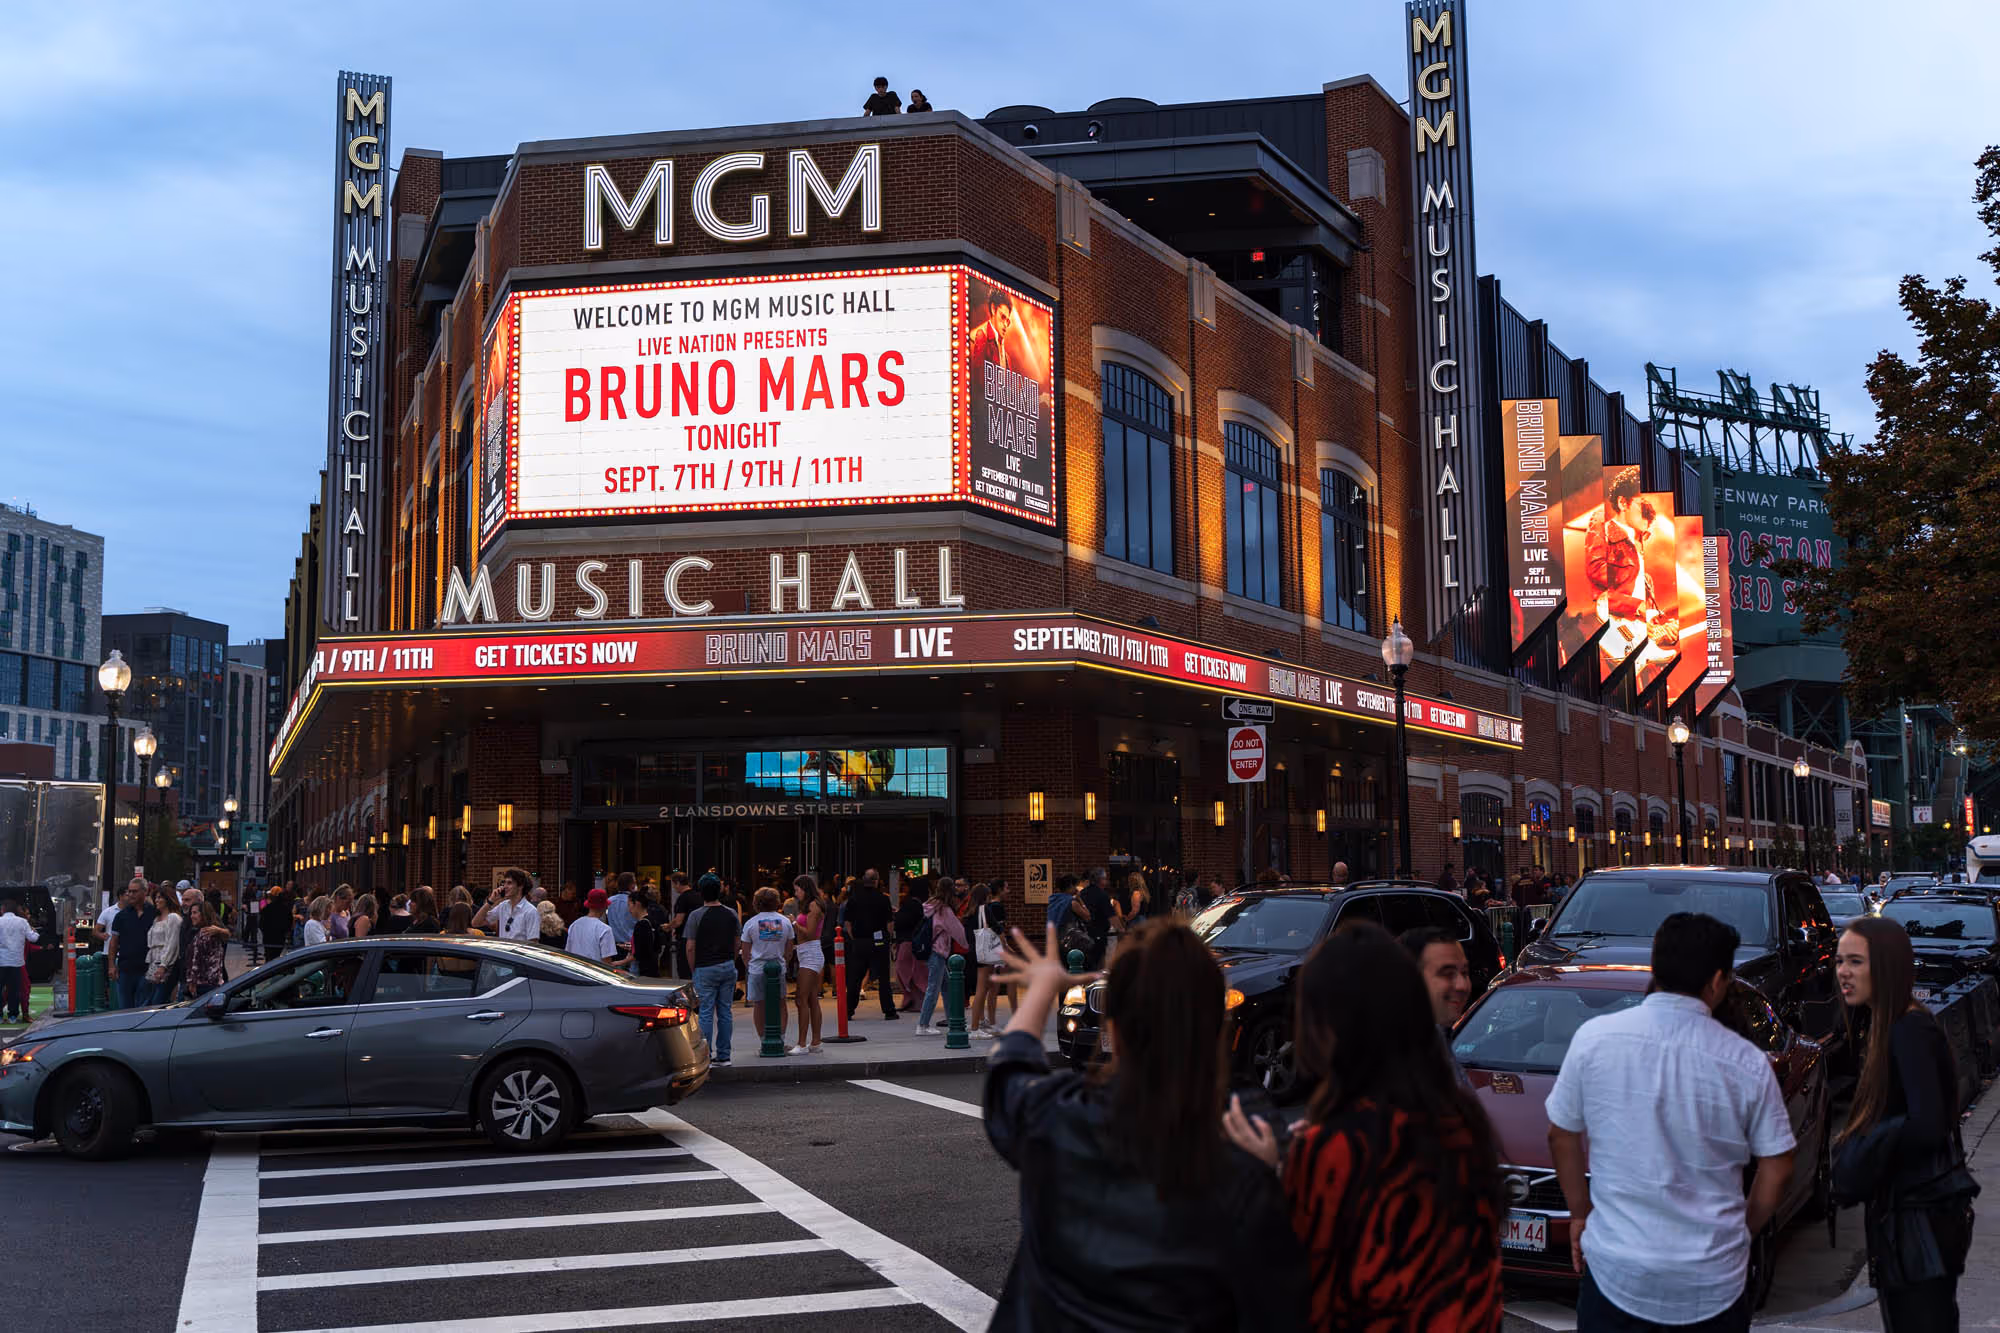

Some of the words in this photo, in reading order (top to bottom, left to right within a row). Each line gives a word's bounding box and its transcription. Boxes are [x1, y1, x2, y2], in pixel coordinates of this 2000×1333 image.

[1412, 11, 1455, 152] MGM
[344, 88, 384, 217] MGM
[583, 144, 882, 250] MGM
[1423, 179, 1458, 393] MUSIC
[574, 303, 673, 329] WELCOME
[681, 301, 704, 323] TO
[713, 297, 759, 321] MGM
[769, 293, 834, 318] MUSIC
[843, 289, 895, 314] HALL
[343, 245, 376, 440] MUSIC
[638, 336, 672, 356] LIVE
[679, 333, 736, 354] NATION
[744, 328, 827, 350] PRESENTS
[564, 359, 736, 423] BRUNO
[759, 350, 906, 413] MARS
[984, 360, 1039, 419] BRUNO
[684, 421, 781, 451] TONIGHT
[988, 404, 1037, 459] MARS
[1516, 400, 1546, 472] BRUNO
[604, 465, 665, 494] SEPT.
[673, 462, 715, 490] 7TH
[723, 459, 733, 491] /
[741, 460, 783, 487] 9TH
[792, 456, 802, 487] /
[811, 456, 863, 484] 11TH
[982, 466, 1008, 485] SEPTEMBER
[1006, 454, 1020, 473] LIVE
[976, 479, 985, 492] GET
[986, 482, 1004, 498] TICKETS
[1434, 414, 1460, 587] HALL
[1714, 487, 1779, 508] FENWAY
[1788, 496, 1830, 515] PARK
[1519, 480, 1549, 543] MARS
[1739, 512, 1767, 524] HOME
[1773, 516, 1786, 526] OF
[1790, 519, 1809, 529] THE
[344, 462, 366, 621] HALL
[1524, 549, 1549, 561] LIVE
[441, 556, 715, 623] MUSIC
[770, 546, 965, 612] HALL
[1529, 567, 1545, 576] SEPT
[342, 648, 375, 671] 9TH
[393, 647, 433, 670] 11TH
[475, 645, 509, 667] GET
[513, 643, 587, 666] TICKETS
[591, 641, 638, 664] NOW
[705, 631, 788, 665] BRUNO
[797, 629, 872, 662] MARS
[894, 627, 953, 658] LIVE
[1013, 627, 1100, 653] SEPTEMBER
[1102, 633, 1119, 657] 7TH
[1126, 638, 1142, 662] 9TH
[1150, 644, 1168, 668] 11TH
[1184, 652, 1198, 674] GET
[1199, 655, 1229, 680] TICKETS
[1229, 662, 1246, 683] NOW
[1325, 680, 1343, 706] LIVE
[1357, 690, 1385, 711] SEPTEMBER
[1430, 706, 1438, 723] GET
[1439, 708, 1456, 727] TICKETS
[1510, 722, 1523, 743] LIVE
[1239, 704, 1252, 714] ONE
[1256, 705, 1270, 715] WAY
[1234, 740, 1244, 748] DO
[1245, 739, 1260, 748] NOT
[1236, 760, 1257, 769] ENTER
[659, 806, 669, 818] 2
[675, 804, 788, 817] LANSDOWNE
[794, 803, 864, 816] STREET
[1524, 1223, 1545, 1243] 44
